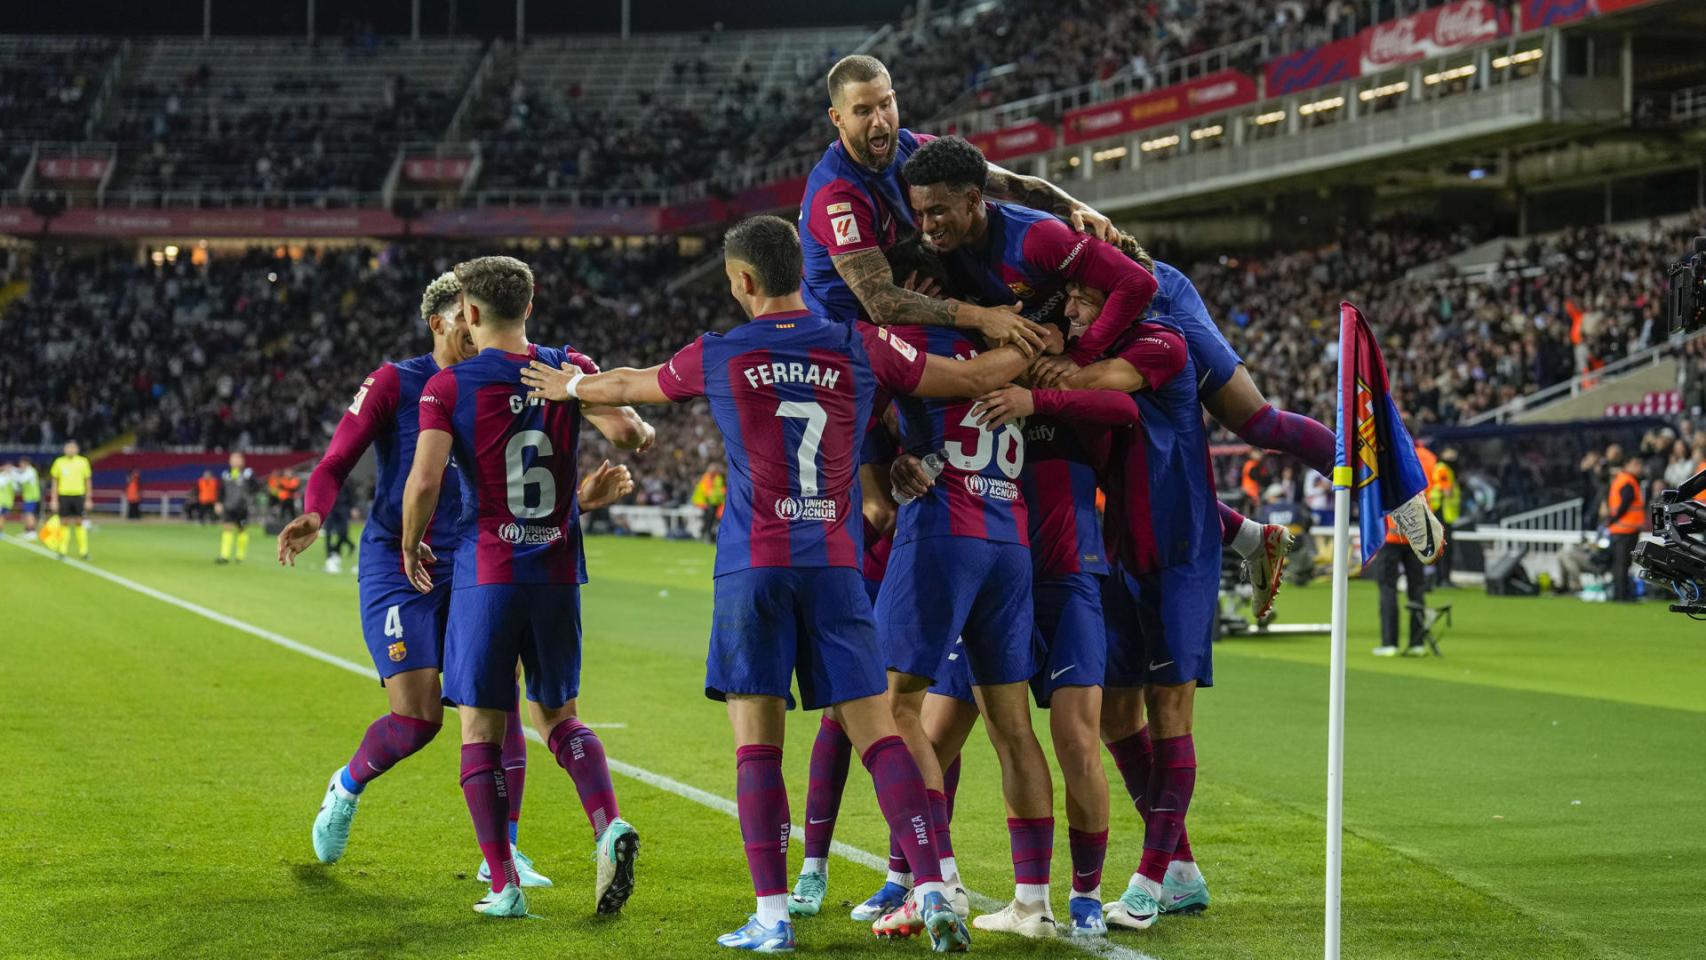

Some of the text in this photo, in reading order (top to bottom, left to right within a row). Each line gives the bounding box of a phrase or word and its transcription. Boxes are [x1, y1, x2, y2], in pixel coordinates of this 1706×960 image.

[744, 362, 840, 390] FERRAN
[775, 401, 828, 497] 7
[505, 430, 556, 519] 6
[988, 478, 1017, 491] UNHCR
[804, 499, 836, 509] UNHCR
[989, 485, 1018, 500] ACNUR
[802, 508, 836, 518] ACNUR
[525, 525, 561, 535] UNHCR
[384, 605, 404, 639] 4
[569, 736, 585, 761] BARÇA
[780, 822, 790, 854] BARÇA
[911, 814, 929, 846] BARÇA
